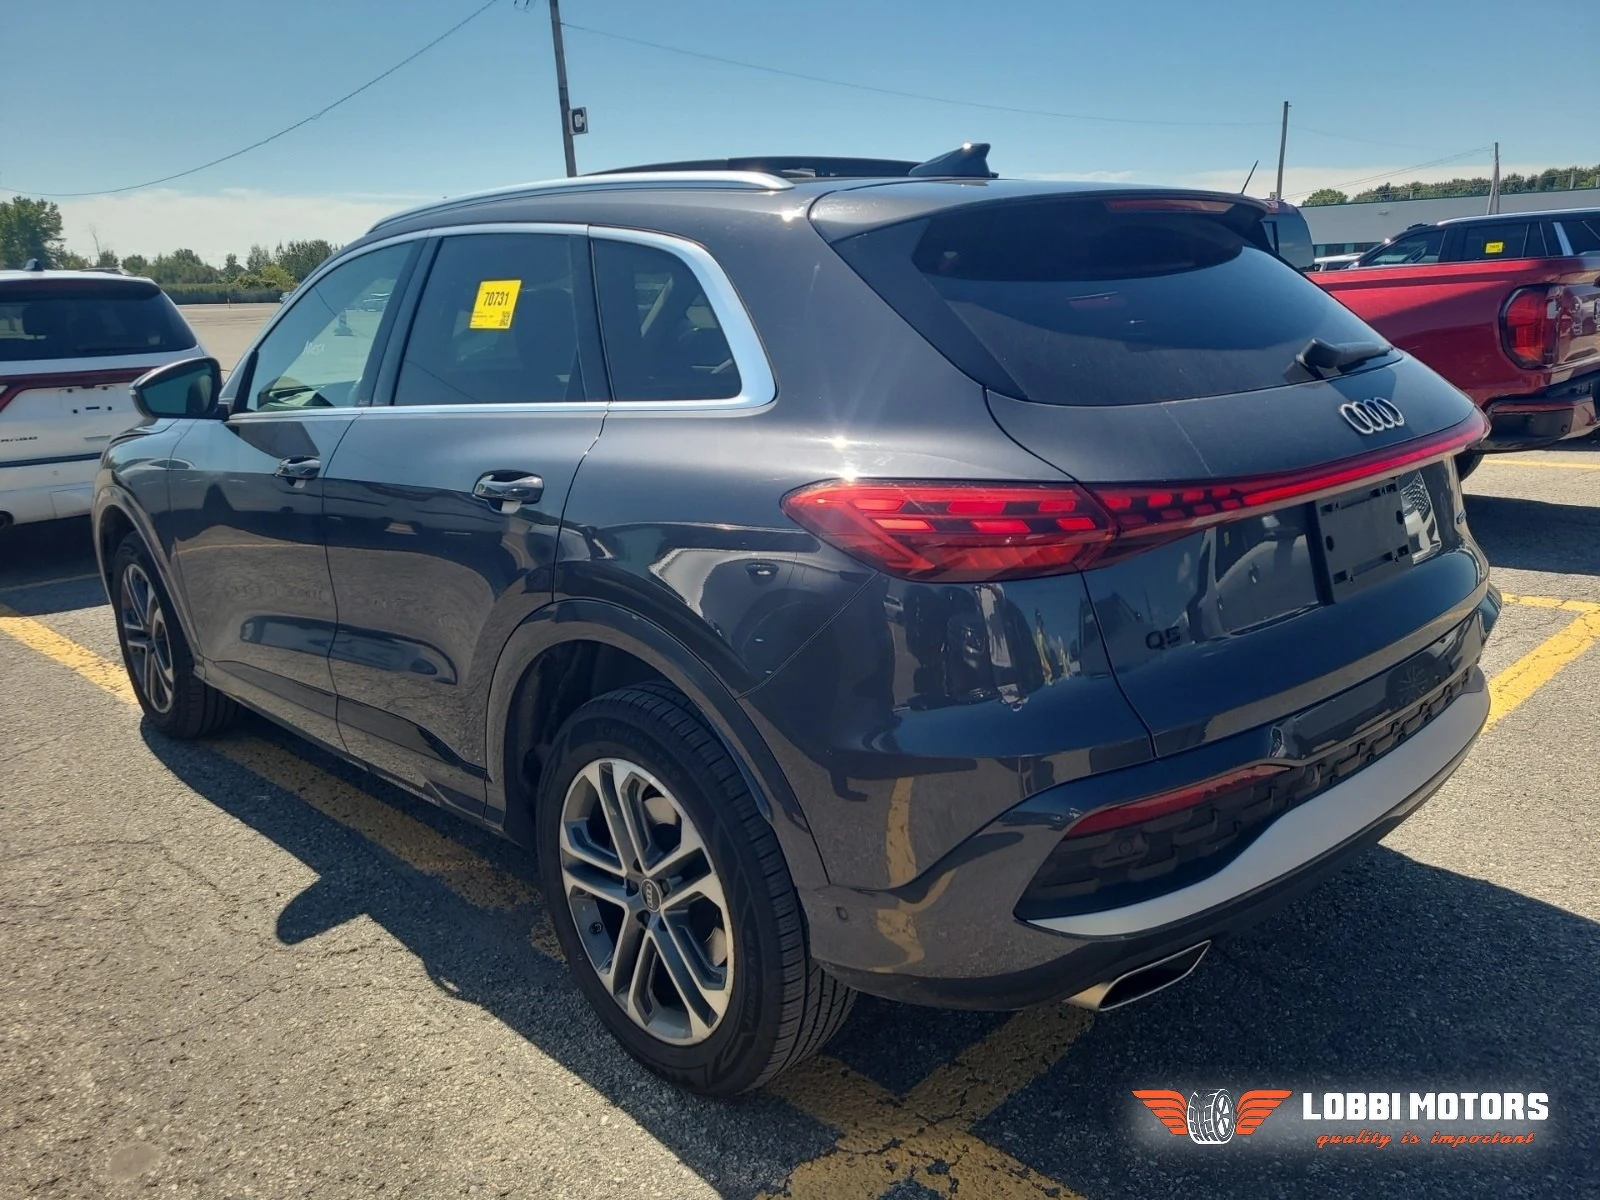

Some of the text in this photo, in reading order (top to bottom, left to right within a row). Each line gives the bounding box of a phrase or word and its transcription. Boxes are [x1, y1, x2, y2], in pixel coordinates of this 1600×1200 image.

[571, 109, 585, 133] C
[483, 291, 510, 307] 70731
[1145, 626, 1181, 650] Q5
